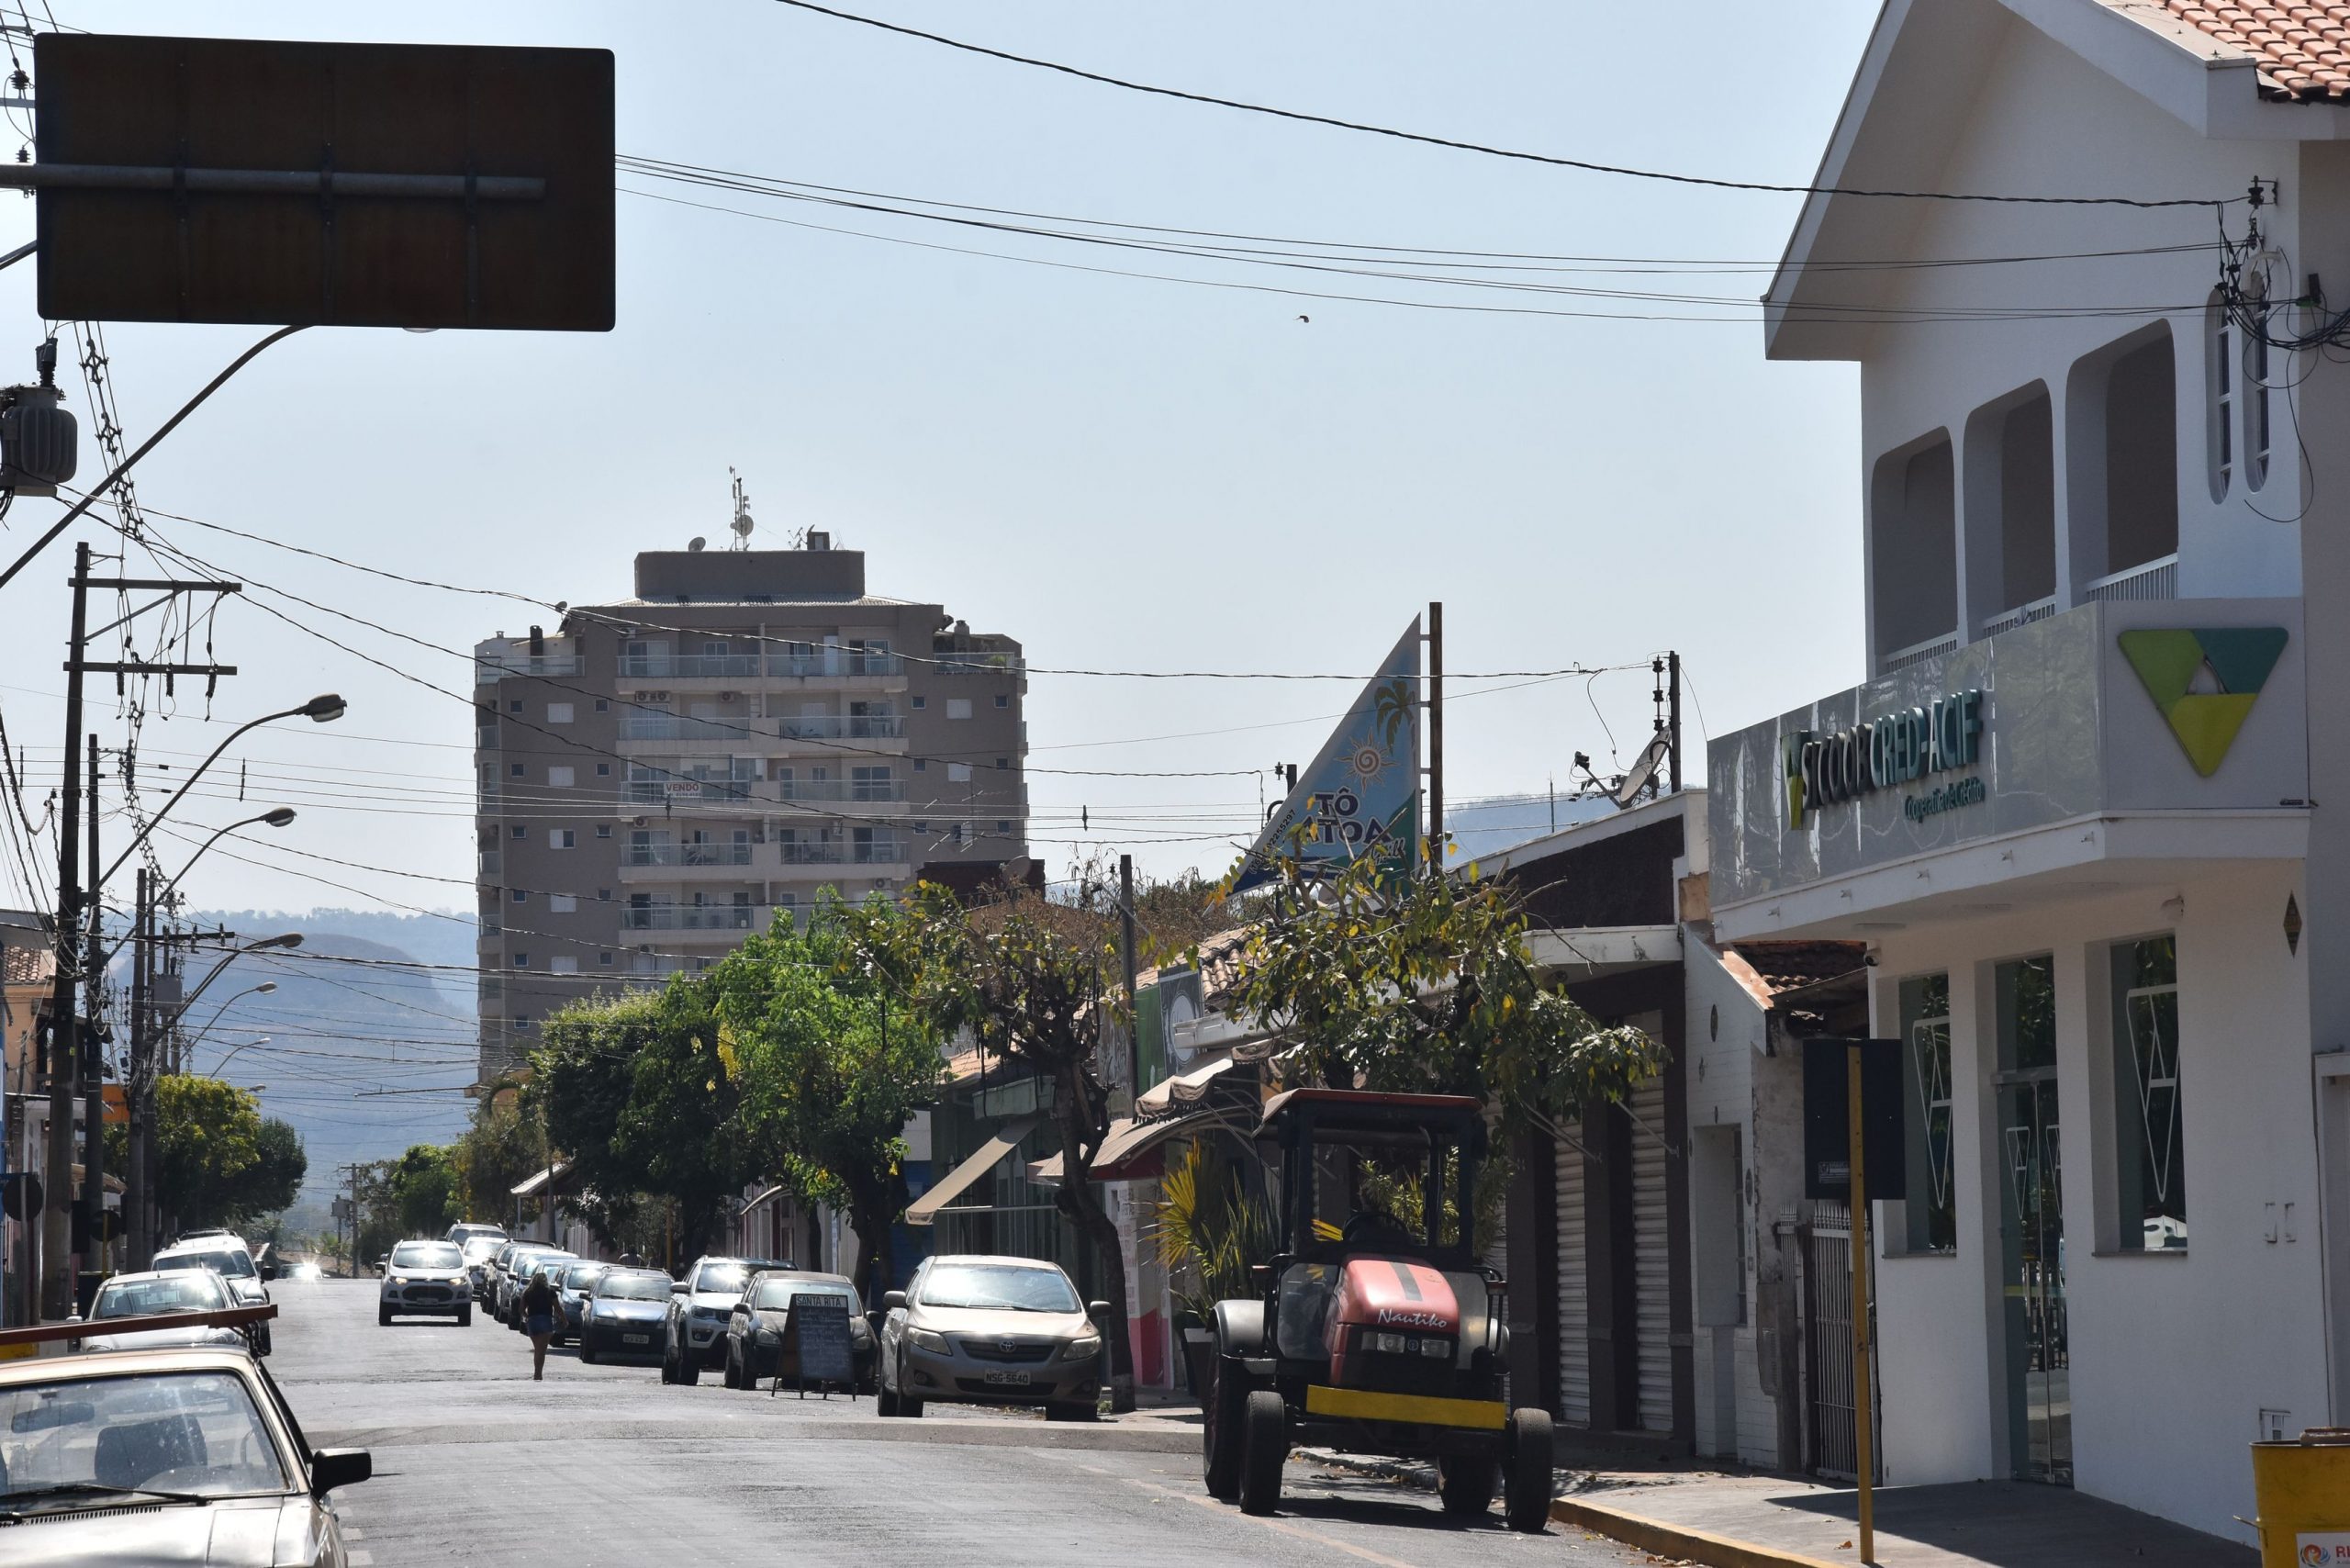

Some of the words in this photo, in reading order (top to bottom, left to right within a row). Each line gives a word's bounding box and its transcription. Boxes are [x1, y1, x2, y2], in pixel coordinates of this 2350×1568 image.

[666, 783, 699, 791] VENDO
[1314, 786, 1360, 816] TÔ
[797, 1296, 822, 1306] SANTA
[824, 1297, 842, 1307] RITA
[1377, 1308, 1447, 1328] Nautiko
